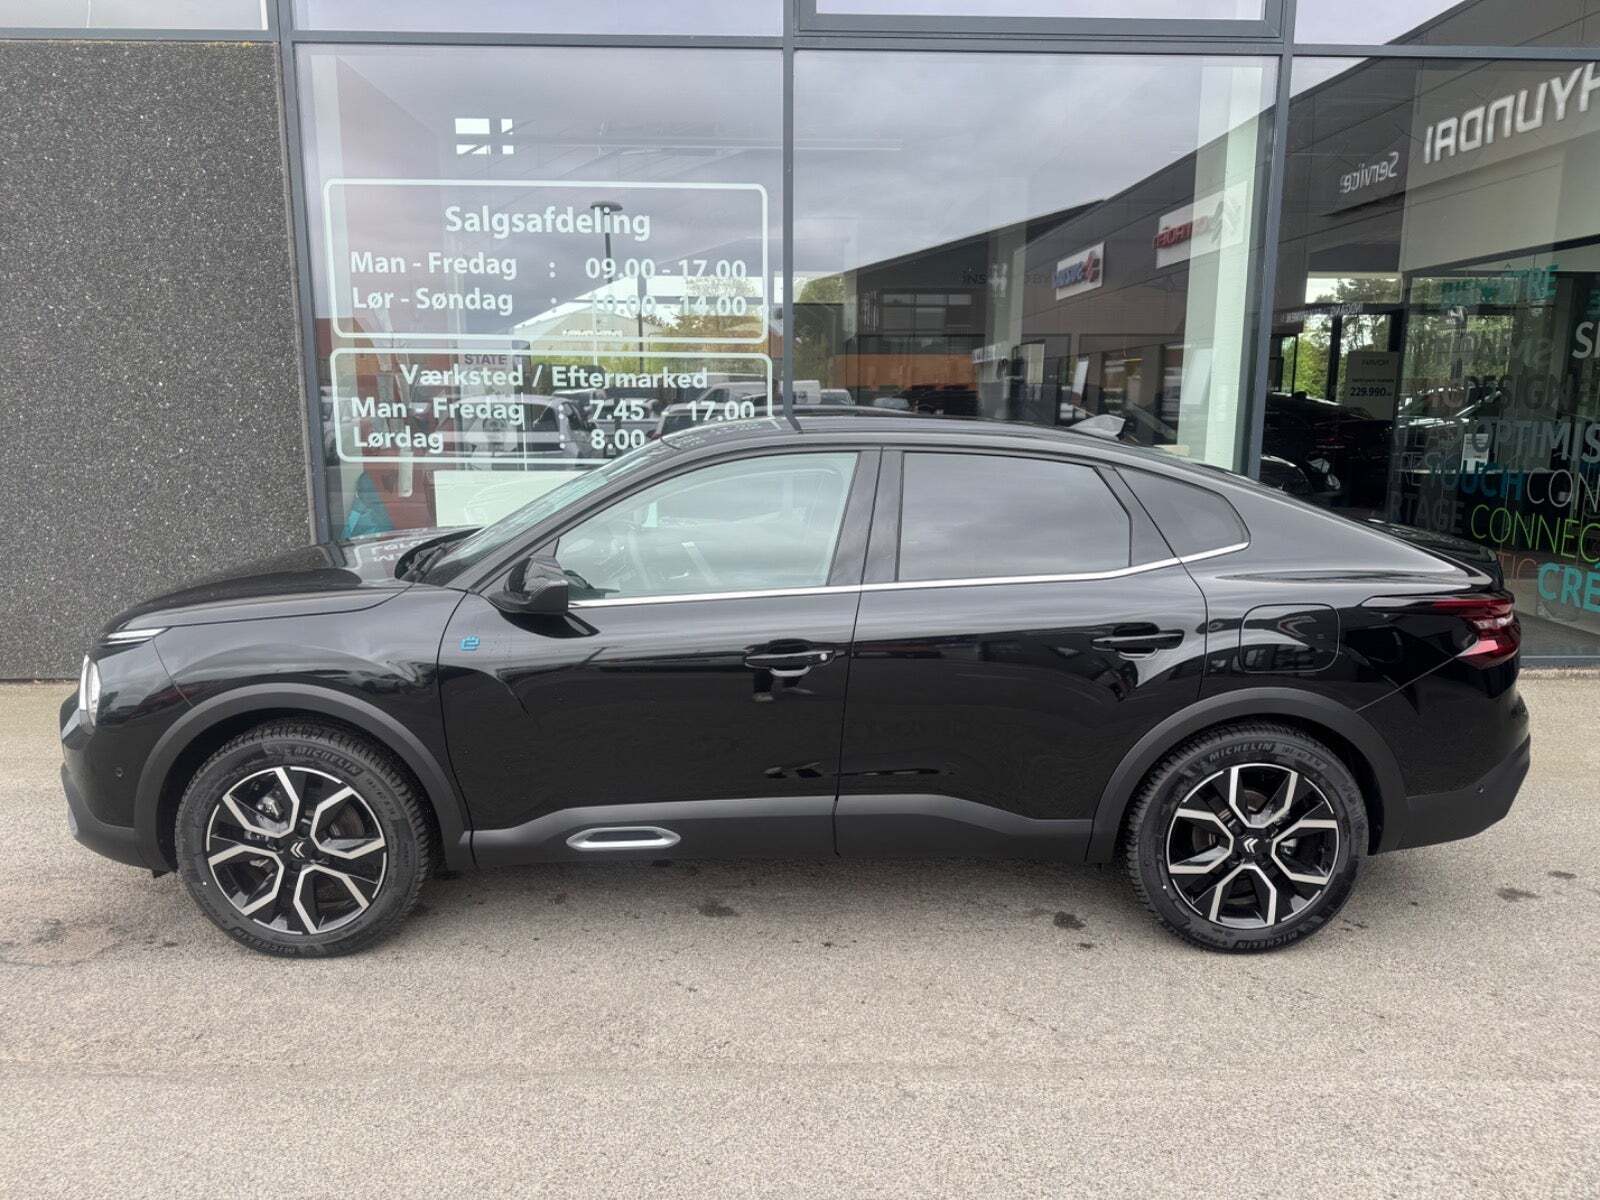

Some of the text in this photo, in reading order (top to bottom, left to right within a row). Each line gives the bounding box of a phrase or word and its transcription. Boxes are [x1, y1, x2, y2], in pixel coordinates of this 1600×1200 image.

[444, 204, 651, 242] Salgsafdeling
[350, 251, 406, 273] Man
[428, 251, 517, 281] Fredag
[585, 257, 656, 279] 09.00
[678, 258, 747, 279] 17.00
[352, 287, 395, 309] Lør
[415, 287, 513, 317] Søndag
[679, 295, 747, 316] 14.00
[464, 353, 508, 365] STATE
[399, 363, 523, 386] Værksted
[551, 365, 707, 388] Eftermarked
[351, 397, 408, 418] Man
[433, 397, 523, 425] Fredag
[589, 399, 645, 421] 7.45
[686, 400, 755, 421] 17.00
[353, 426, 444, 453] Lørdag
[590, 428, 645, 450] 8.00
[1209, 743, 1272, 762] MICHELIN
